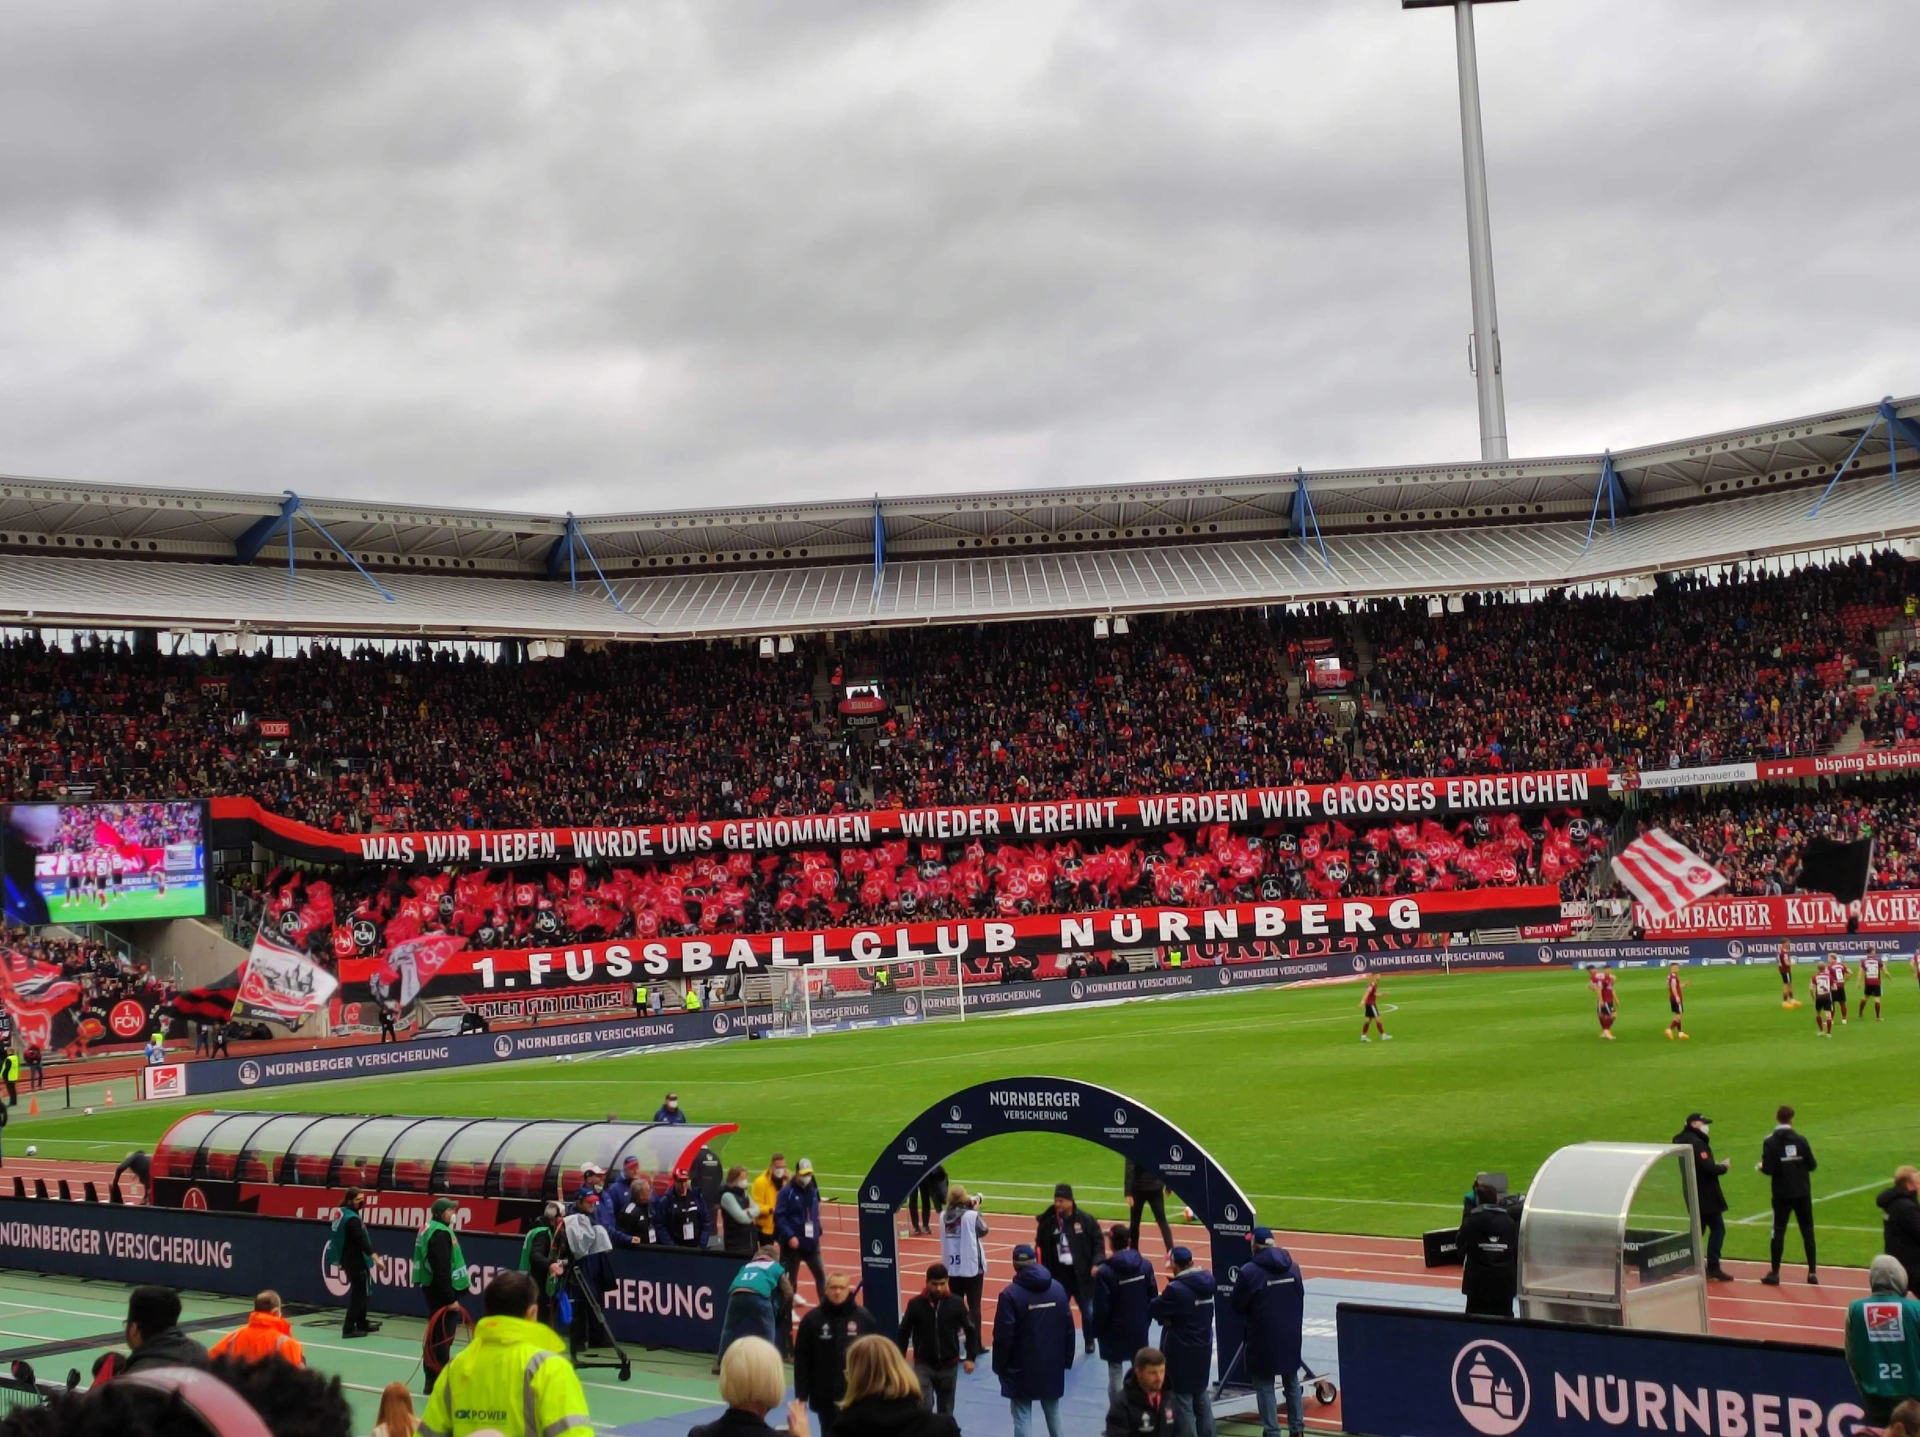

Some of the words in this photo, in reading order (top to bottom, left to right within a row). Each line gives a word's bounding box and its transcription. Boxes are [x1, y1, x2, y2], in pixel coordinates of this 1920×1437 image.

[1815, 753, 1864, 772] bisping
[1866, 755, 1877, 766] &
[1646, 768, 1746, 786] www.gold-hanauer.de
[360, 836, 414, 863] WAS
[423, 834, 470, 863] WIR
[480, 831, 560, 863] LIEBEN,
[571, 829, 654, 858] WURDE
[661, 825, 713, 855] UNS
[723, 816, 871, 849] GENOMMEN
[899, 808, 1000, 838] WIEDER
[1010, 801, 1127, 834] VEREINT,
[1138, 793, 1248, 827] WERDEN
[1258, 787, 1311, 819] WIR
[1321, 782, 1436, 815] GROSSES
[1446, 773, 1589, 808] ERREICHEN
[1060, 898, 1421, 948] NÜRNBERG
[1636, 904, 1772, 929] KULMBACHER
[354, 930, 373, 941] FCN
[1556, 946, 1617, 958] NÜRNBERGER
[1619, 945, 1690, 957] VERSICHERUNG
[1747, 940, 1816, 953] NÜRNRGER
[1369, 953, 1432, 966] NÜRNBERGER
[1138, 975, 1193, 989] VERSICHERUNG
[980, 989, 1041, 1003] VERSICHERUNG
[114, 1016, 140, 1028] FCN
[517, 1031, 592, 1050] NÜRNBERGER
[595, 1023, 675, 1042] VERSICHERUNG
[266, 1056, 352, 1077] NÜRNBERGER
[355, 1046, 449, 1067] VERSICHERUNG
[989, 1091, 1081, 1107] NÜRNBERGER
[1003, 1110, 1068, 1121] VERSICHERUNG
[0, 1221, 100, 1255] NÜRNBERGER
[104, 1230, 232, 1268] VERSICHERUNG
[740, 1271, 758, 1281] 17
[1879, 1363, 1903, 1379] 22
[1554, 1371, 1866, 1437] NÜRNBERG
